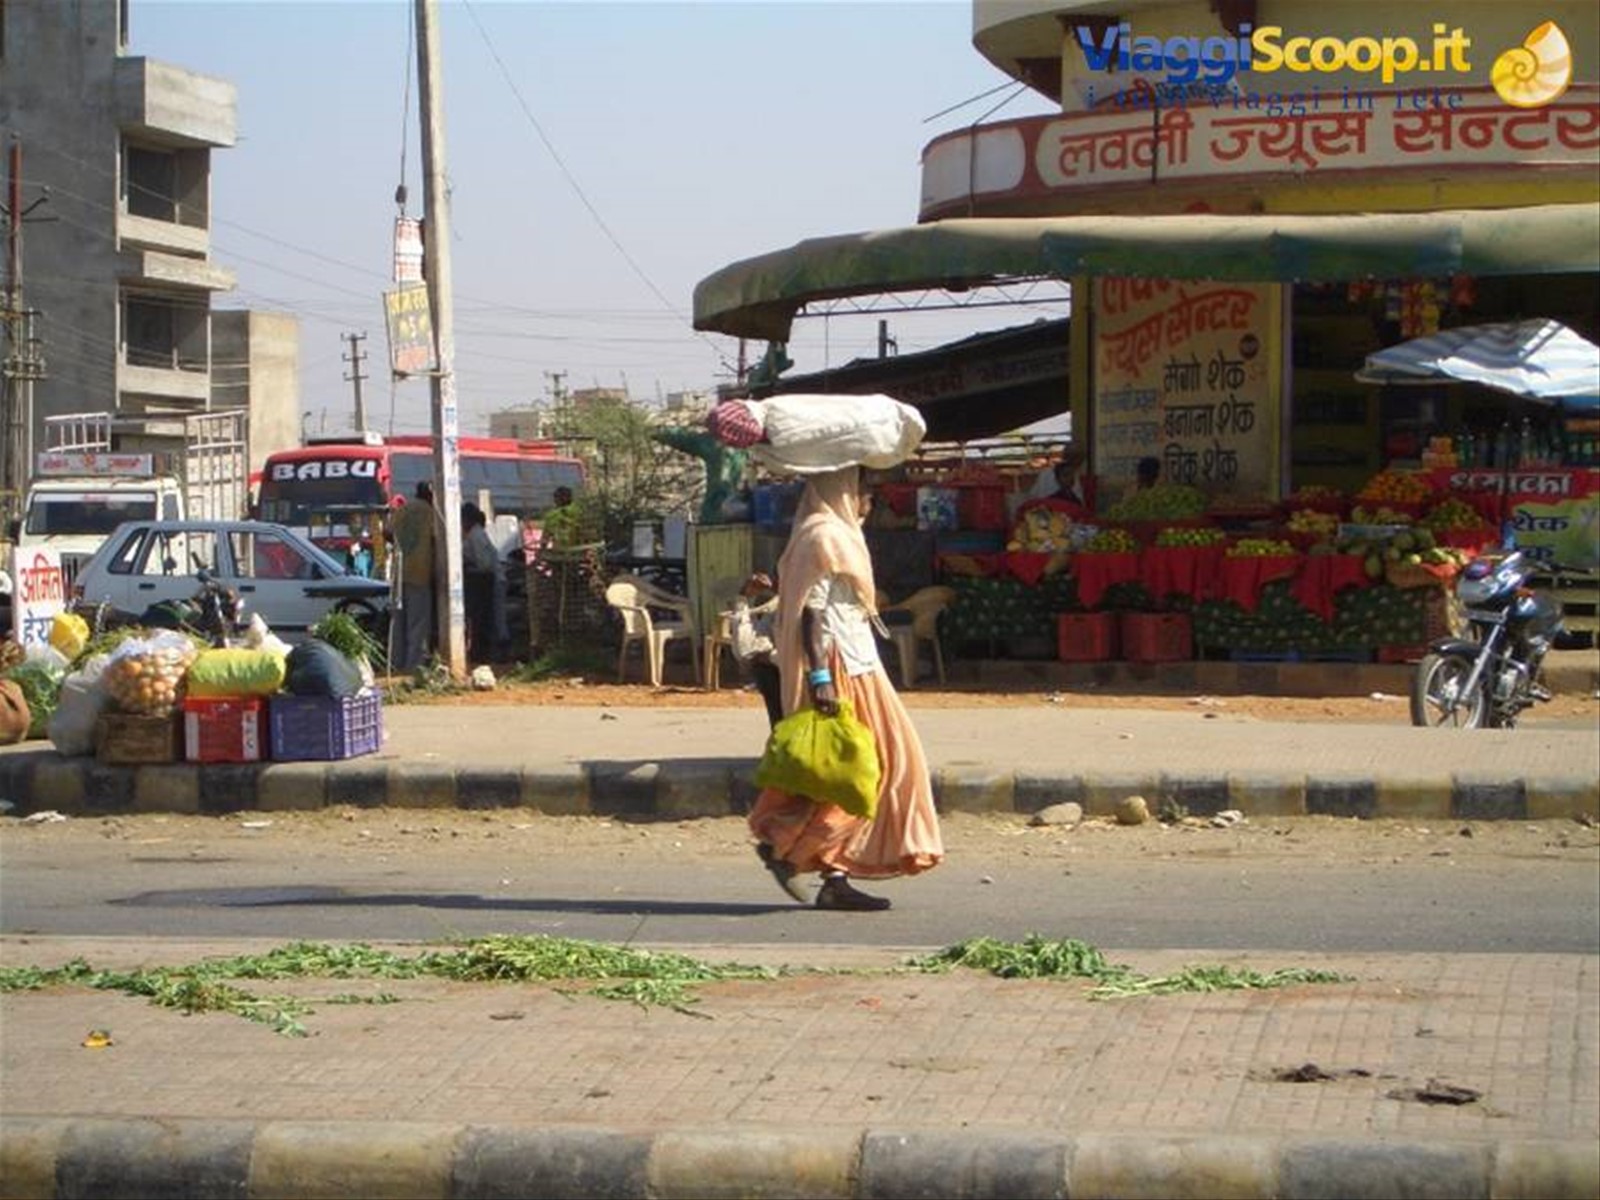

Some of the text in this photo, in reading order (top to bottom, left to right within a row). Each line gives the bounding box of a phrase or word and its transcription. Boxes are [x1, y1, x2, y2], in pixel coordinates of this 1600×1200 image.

[1058, 108, 1195, 178] लवली
[1209, 110, 1374, 170] ज्यूस
[271, 460, 377, 482] BABU
